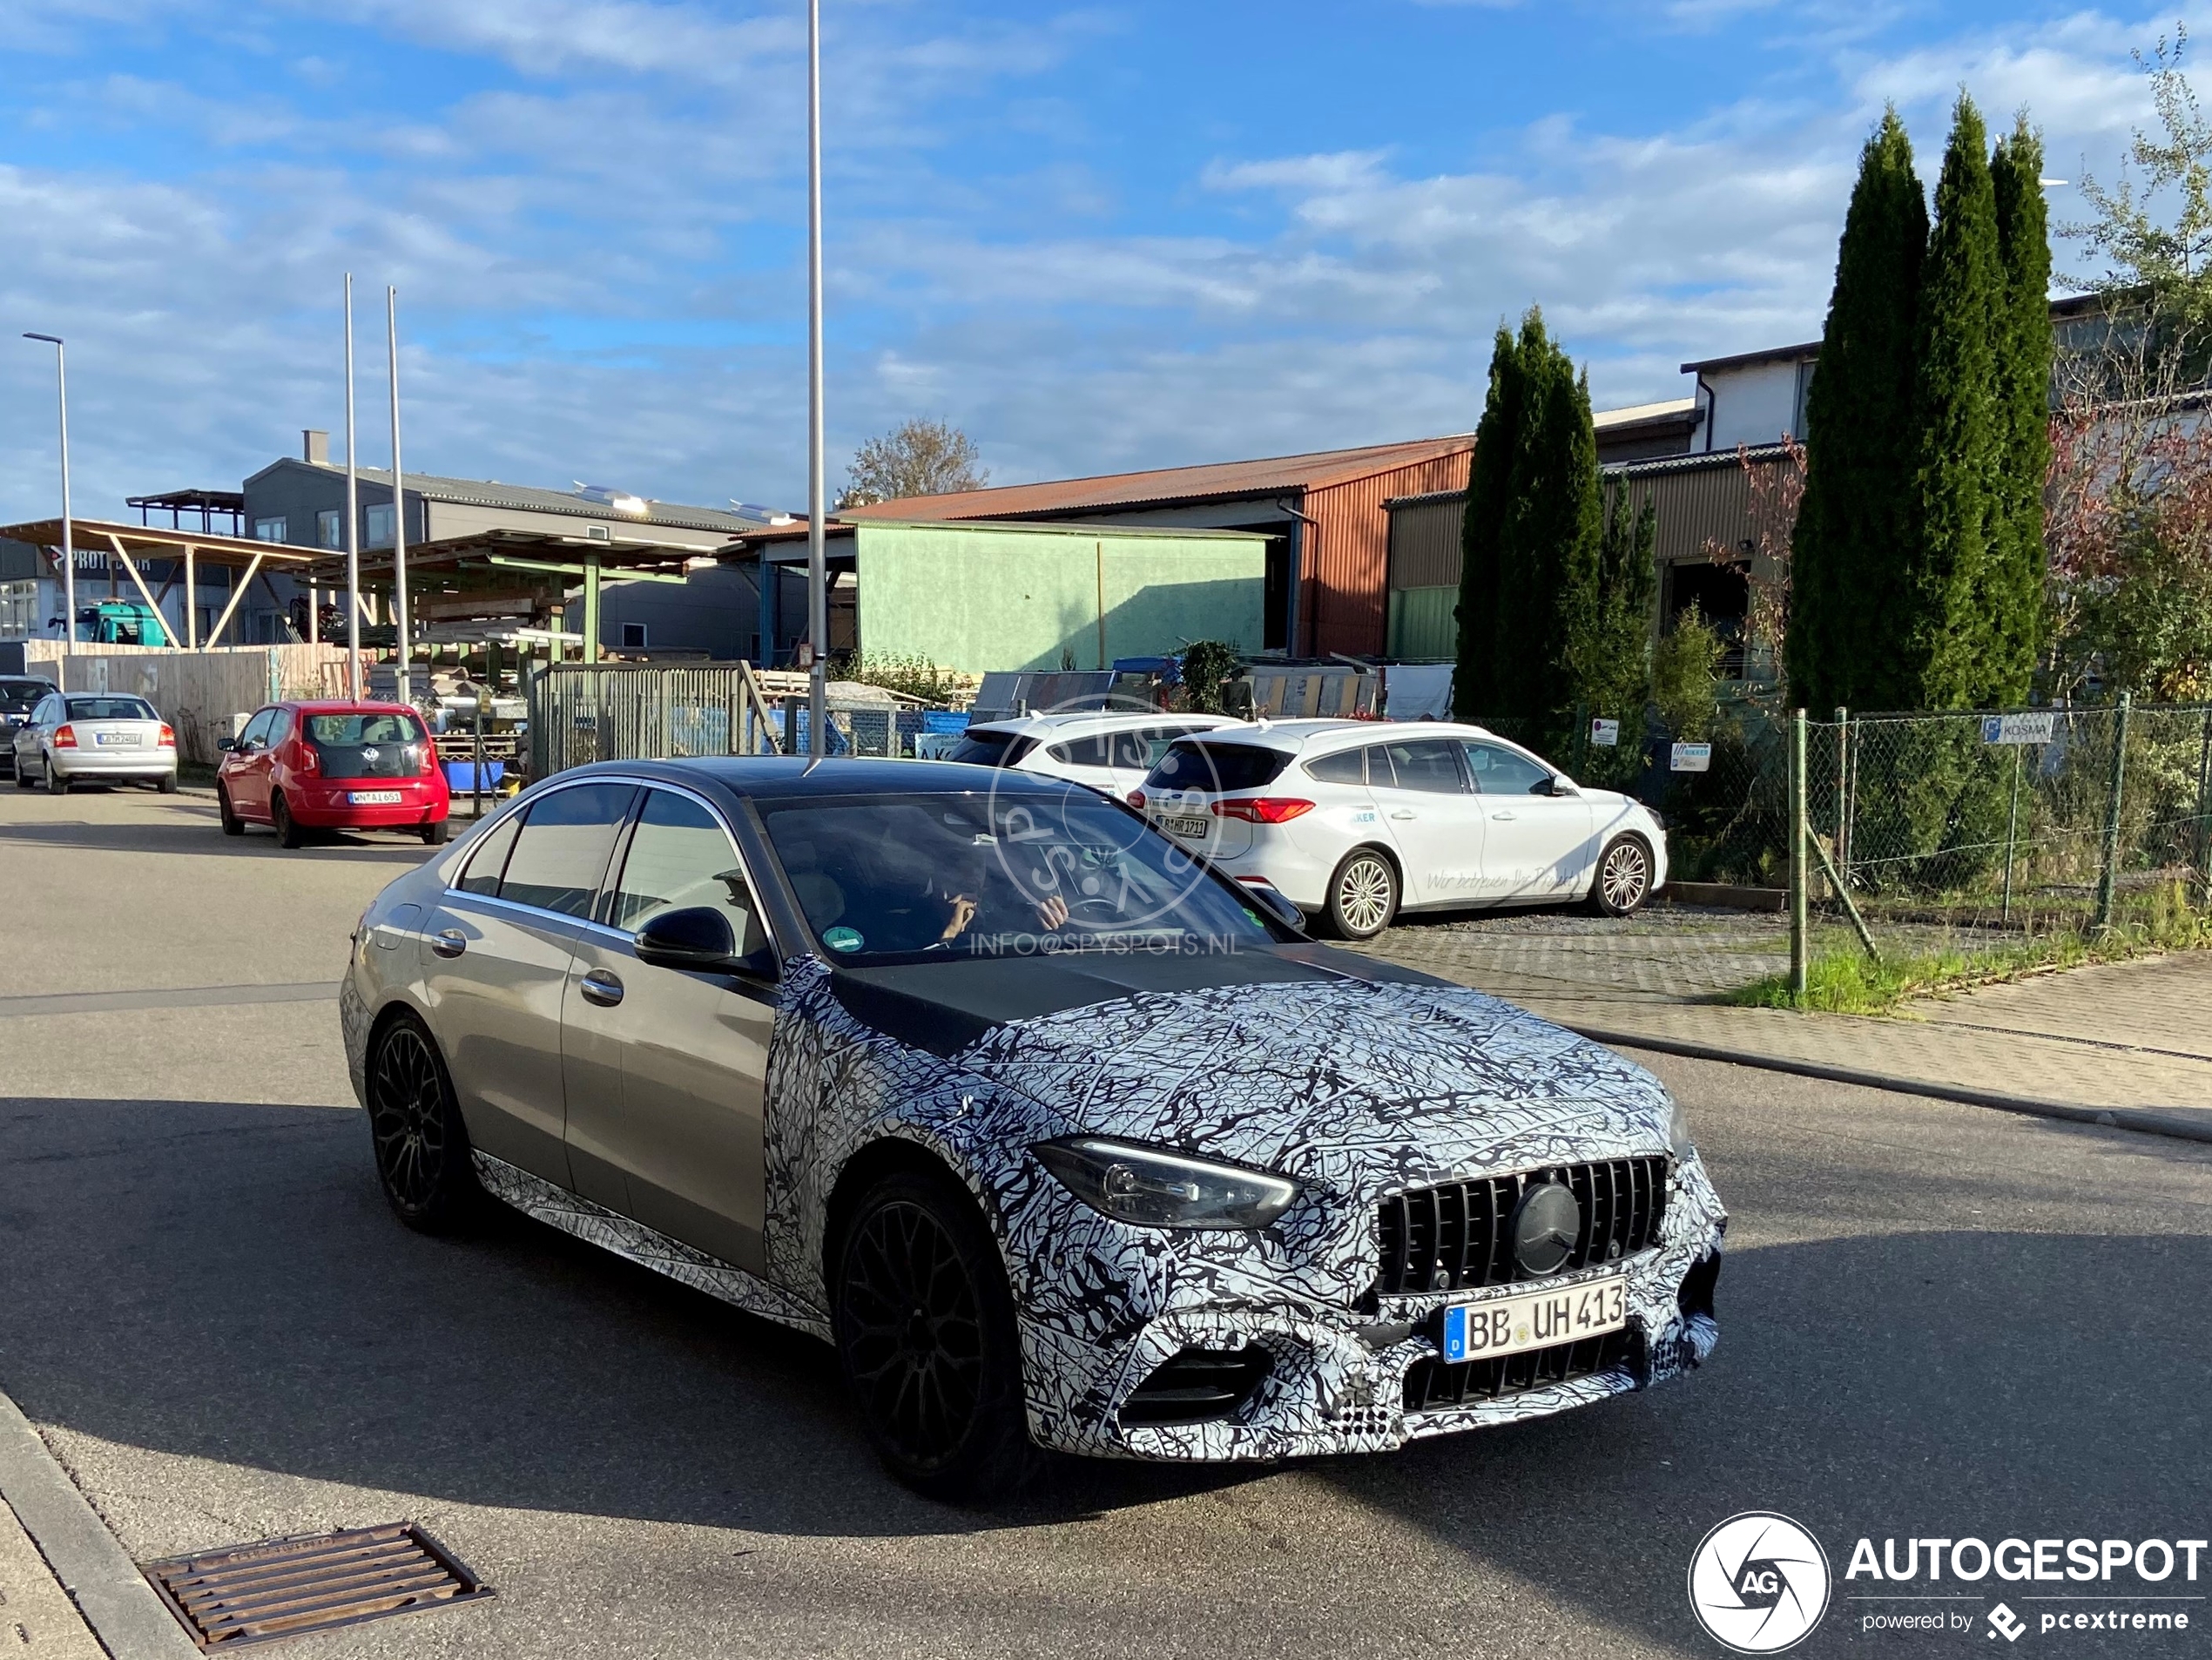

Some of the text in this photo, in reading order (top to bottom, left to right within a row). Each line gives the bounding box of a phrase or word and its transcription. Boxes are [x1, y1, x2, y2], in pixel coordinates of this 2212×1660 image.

[2004, 724, 2047, 736] KOSMA
[1174, 820, 1184, 832] HR
[1184, 820, 1204, 833] 1711
[1427, 871, 1452, 890] Wir
[1457, 872, 1508, 889] betreuen
[1468, 1307, 1511, 1351] BB
[1534, 1297, 1570, 1339] UH
[1577, 1285, 1623, 1329] 413
